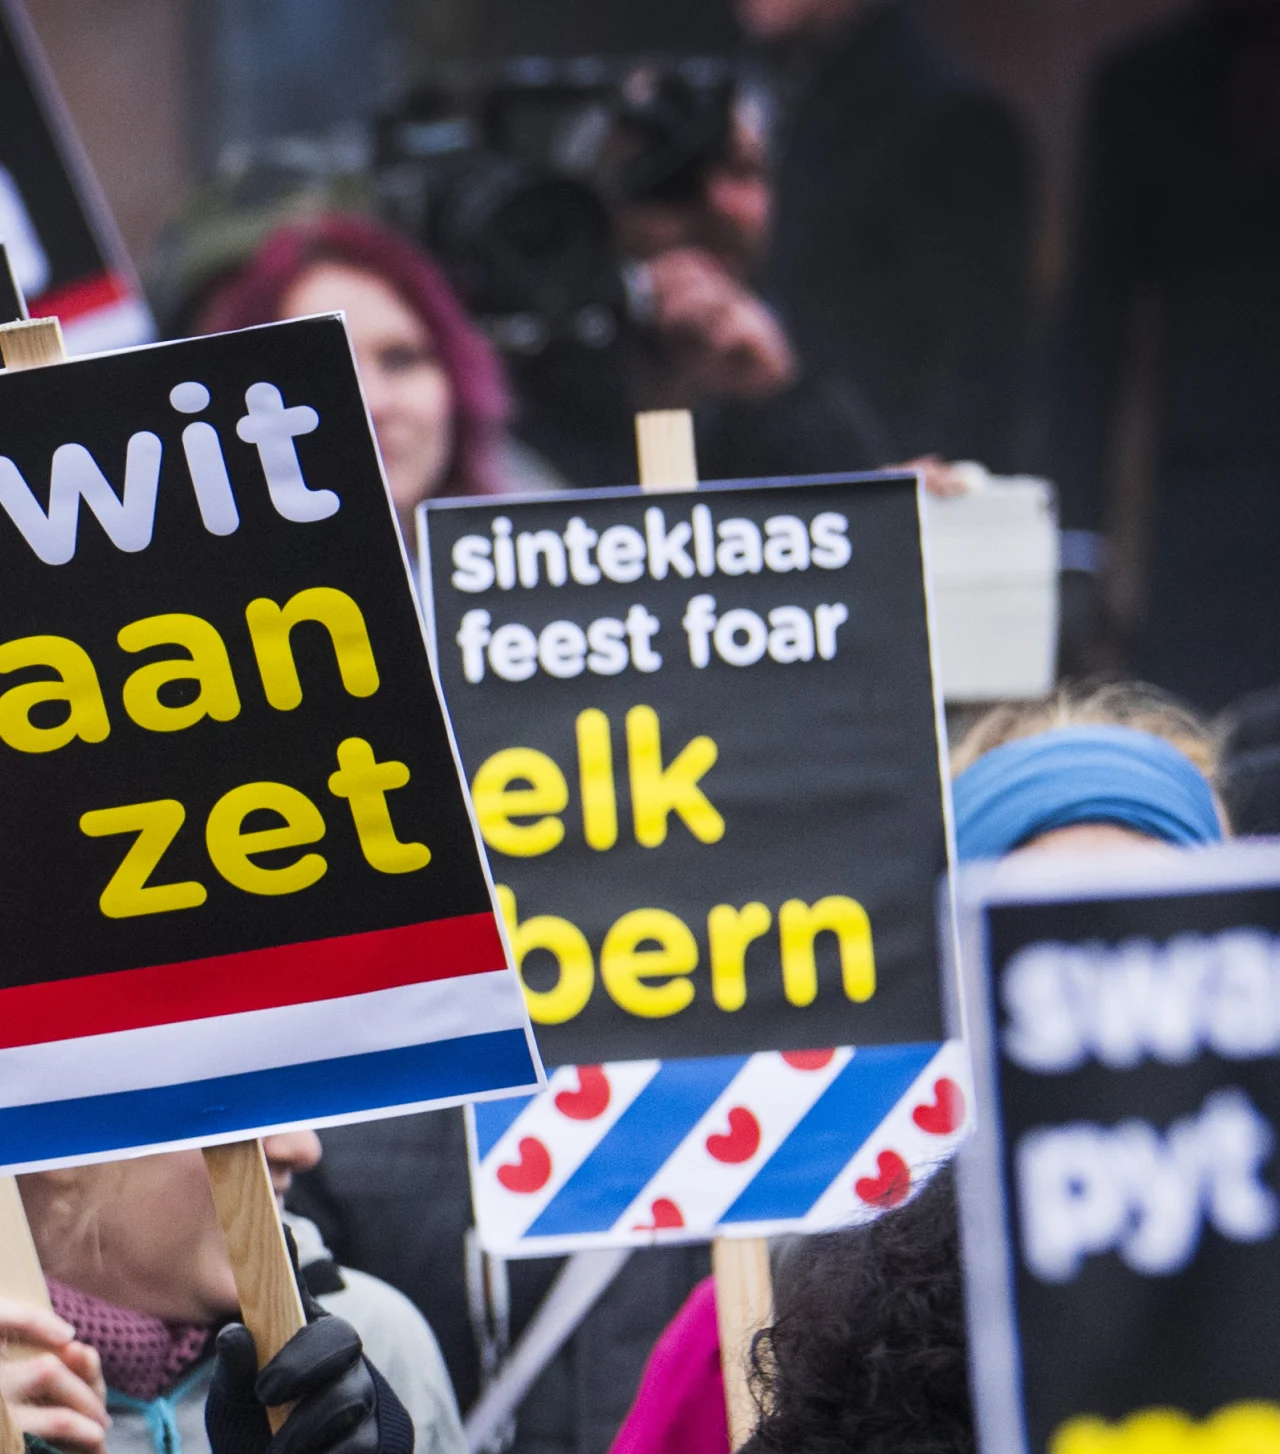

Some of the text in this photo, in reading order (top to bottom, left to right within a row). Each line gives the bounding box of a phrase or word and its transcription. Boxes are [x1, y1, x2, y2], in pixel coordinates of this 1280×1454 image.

[451, 503, 852, 592] sinteklaas
[456, 594, 849, 683] feest foar
[79, 737, 431, 918] zet
[472, 706, 724, 857] elk
[498, 887, 876, 1024] bern
[1017, 1093, 1278, 1280] pyt
